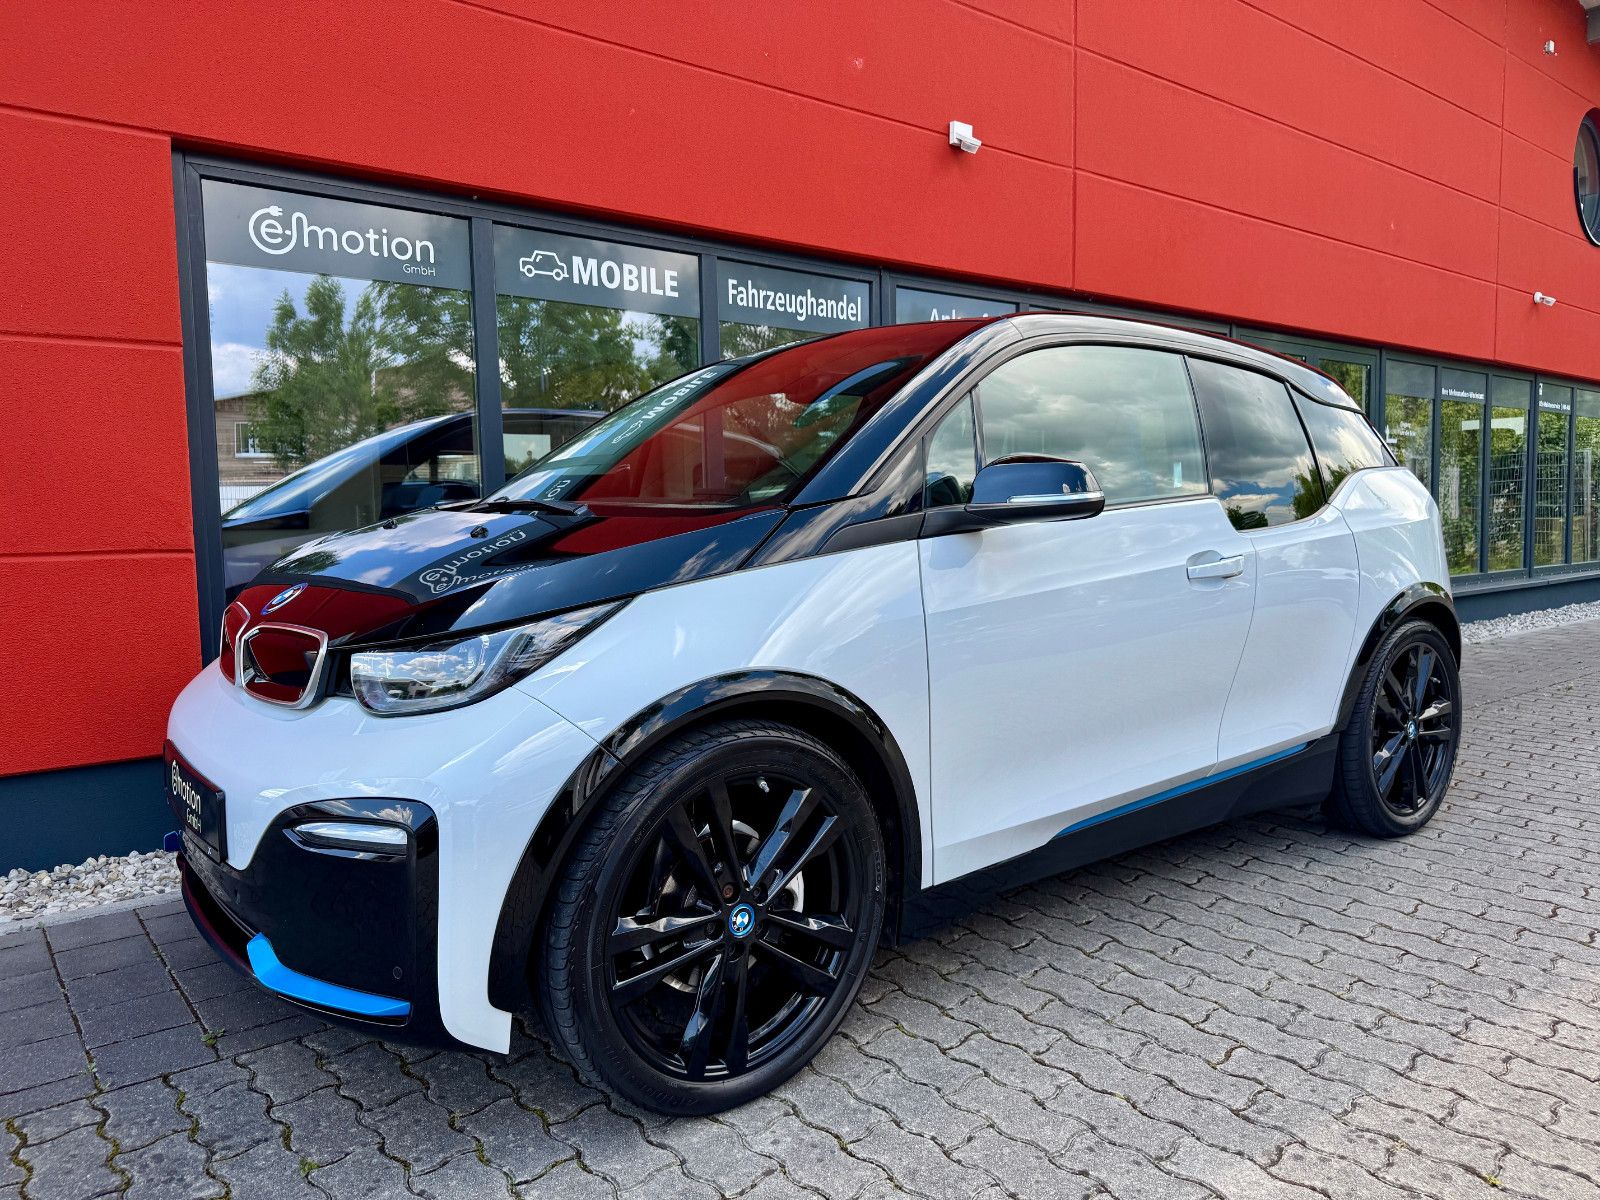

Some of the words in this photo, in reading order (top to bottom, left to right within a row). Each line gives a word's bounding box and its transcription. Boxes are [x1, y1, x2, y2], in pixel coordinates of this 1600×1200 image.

[403, 263, 436, 277] GmbH
[572, 255, 679, 298] MOBILE
[728, 278, 862, 322] Fahrzeughandel
